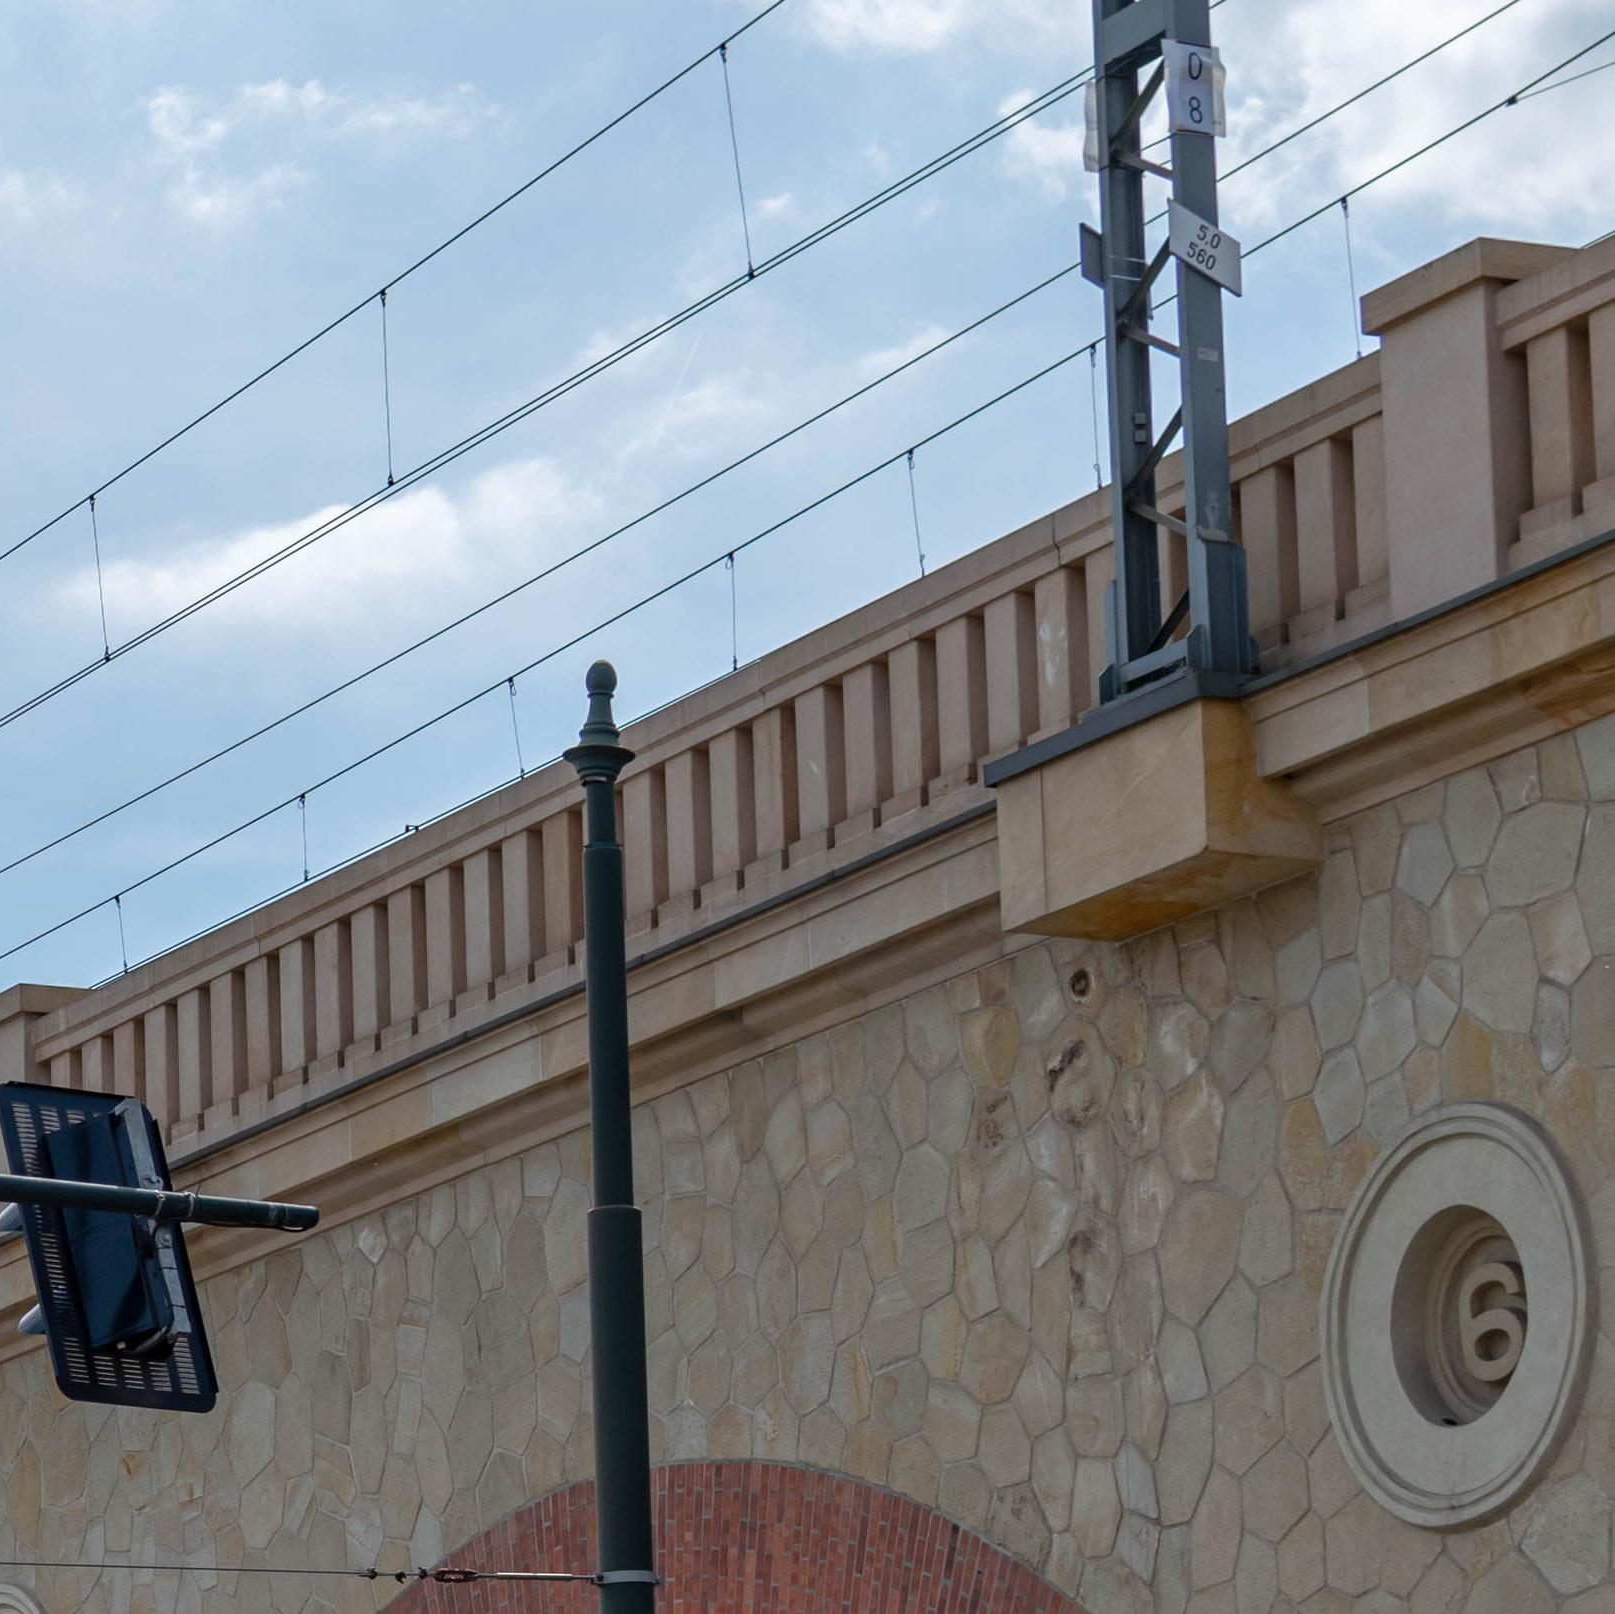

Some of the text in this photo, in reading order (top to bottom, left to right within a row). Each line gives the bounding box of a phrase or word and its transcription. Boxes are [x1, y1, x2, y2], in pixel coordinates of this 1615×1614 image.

[1189, 96, 1203, 124] 8
[1186, 241, 1216, 270] 560
[1458, 1262, 1523, 1382] 6
